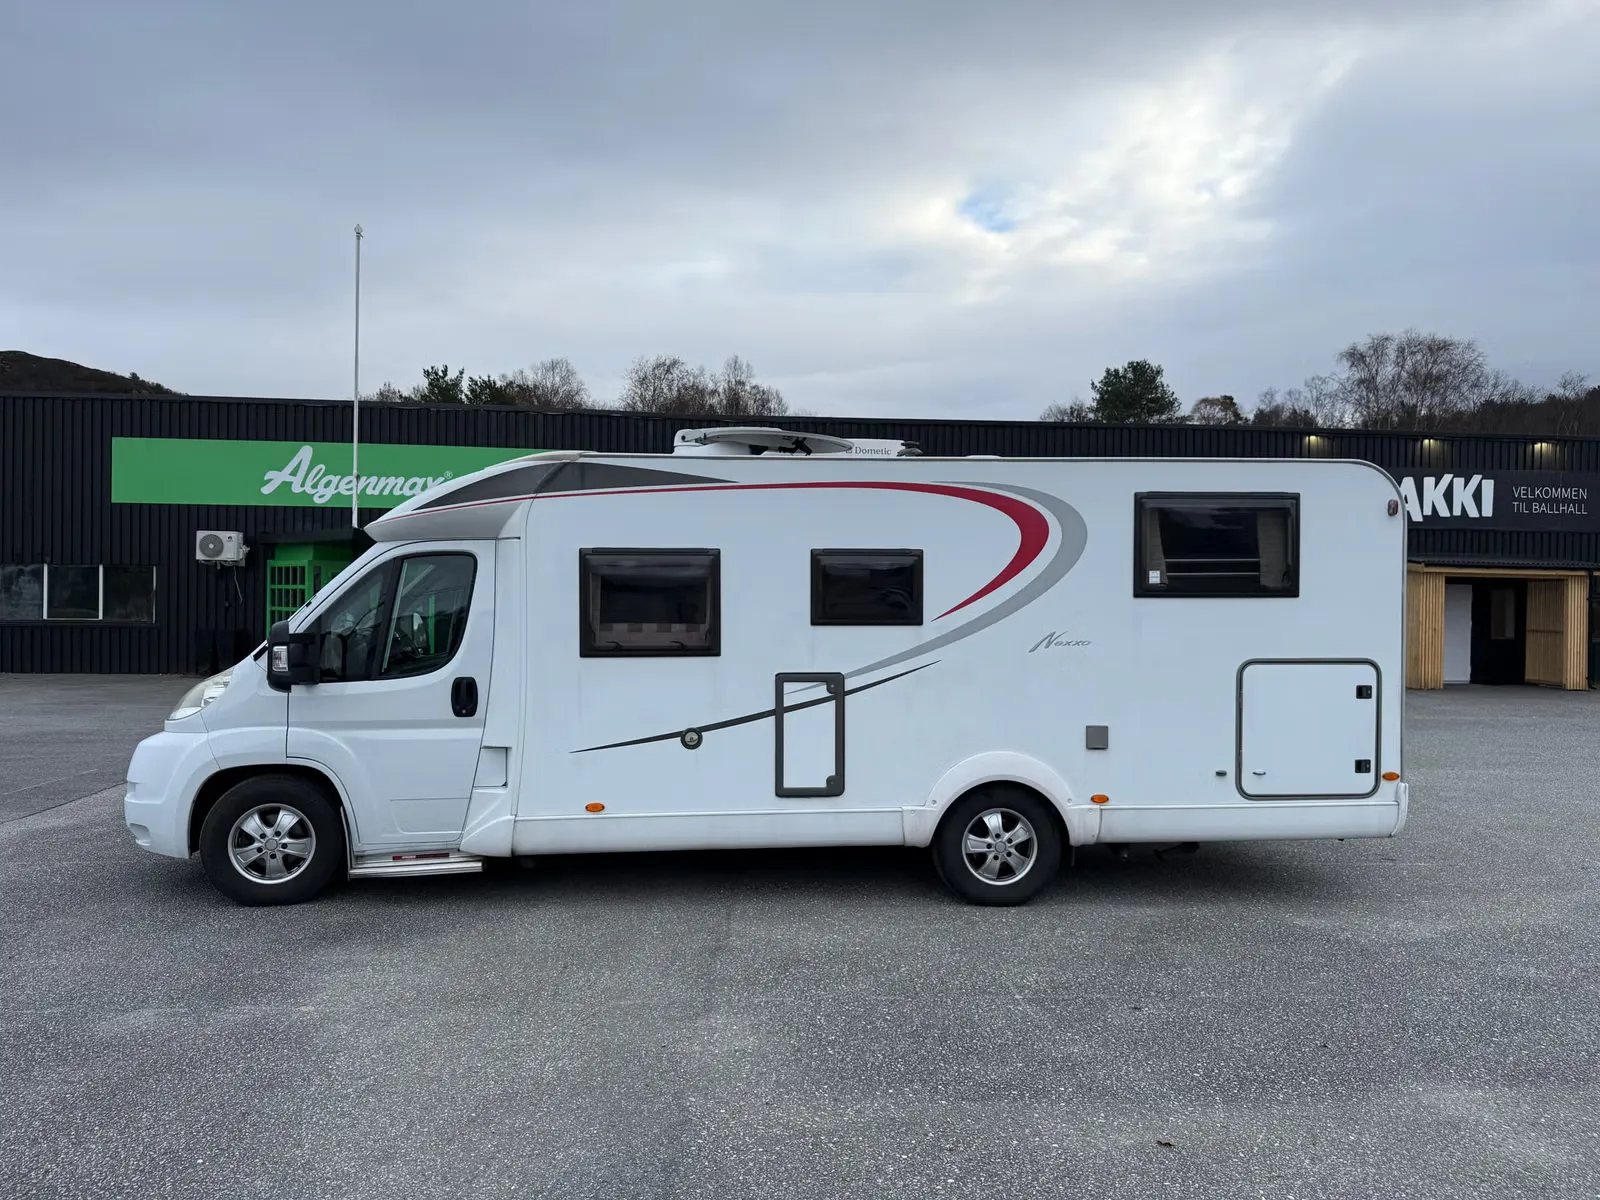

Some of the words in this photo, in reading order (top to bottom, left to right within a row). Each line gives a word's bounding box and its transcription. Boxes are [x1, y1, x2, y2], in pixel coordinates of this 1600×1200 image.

[854, 446, 892, 456] Dometic
[1399, 473, 1495, 522] AKKI
[1512, 486, 1588, 500] VELKOMMEN
[1512, 501, 1529, 513] TIL
[1532, 502, 1588, 515] BALLHALL
[1028, 629, 1092, 653] Nexxo
